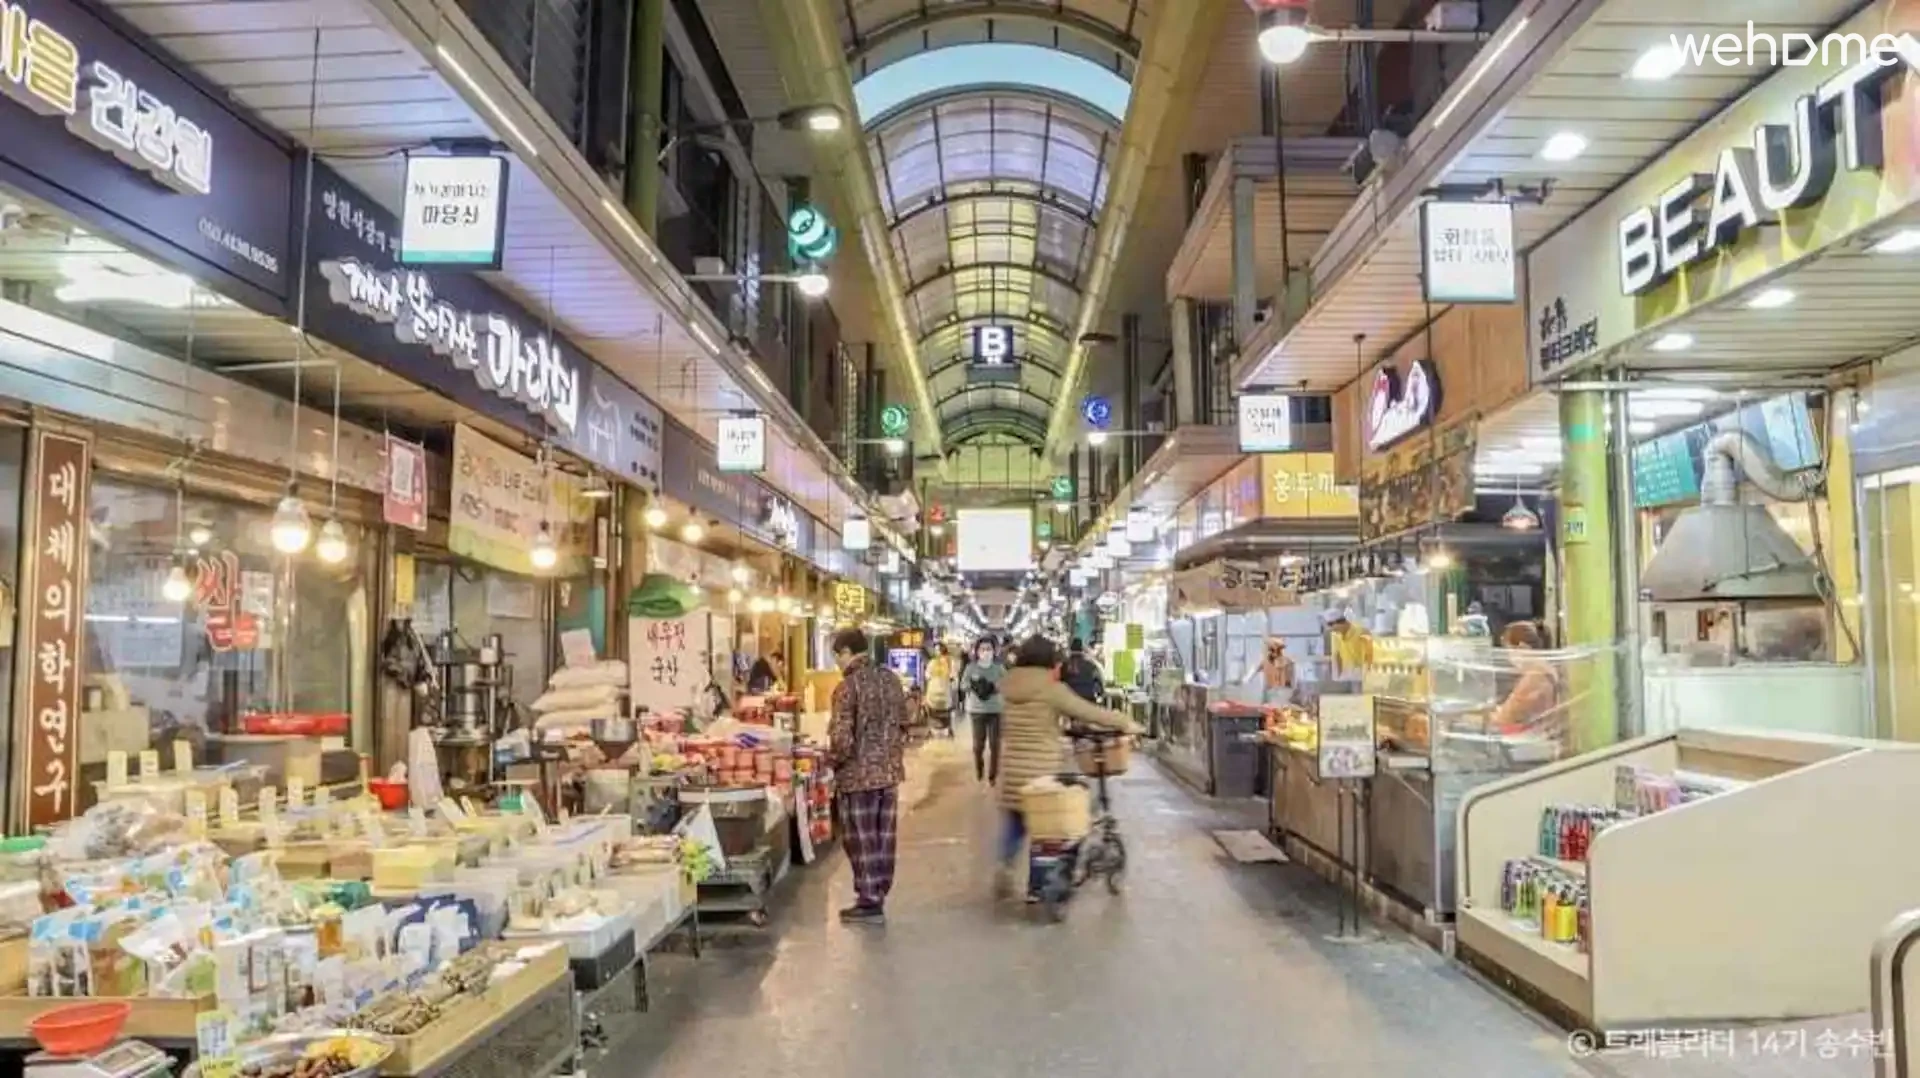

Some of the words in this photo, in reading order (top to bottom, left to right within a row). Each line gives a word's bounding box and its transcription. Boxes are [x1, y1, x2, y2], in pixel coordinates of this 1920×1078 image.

[90, 60, 212, 194] 건강원
[981, 327, 1007, 357] B
[34, 461, 76, 813] 대체의학연구
